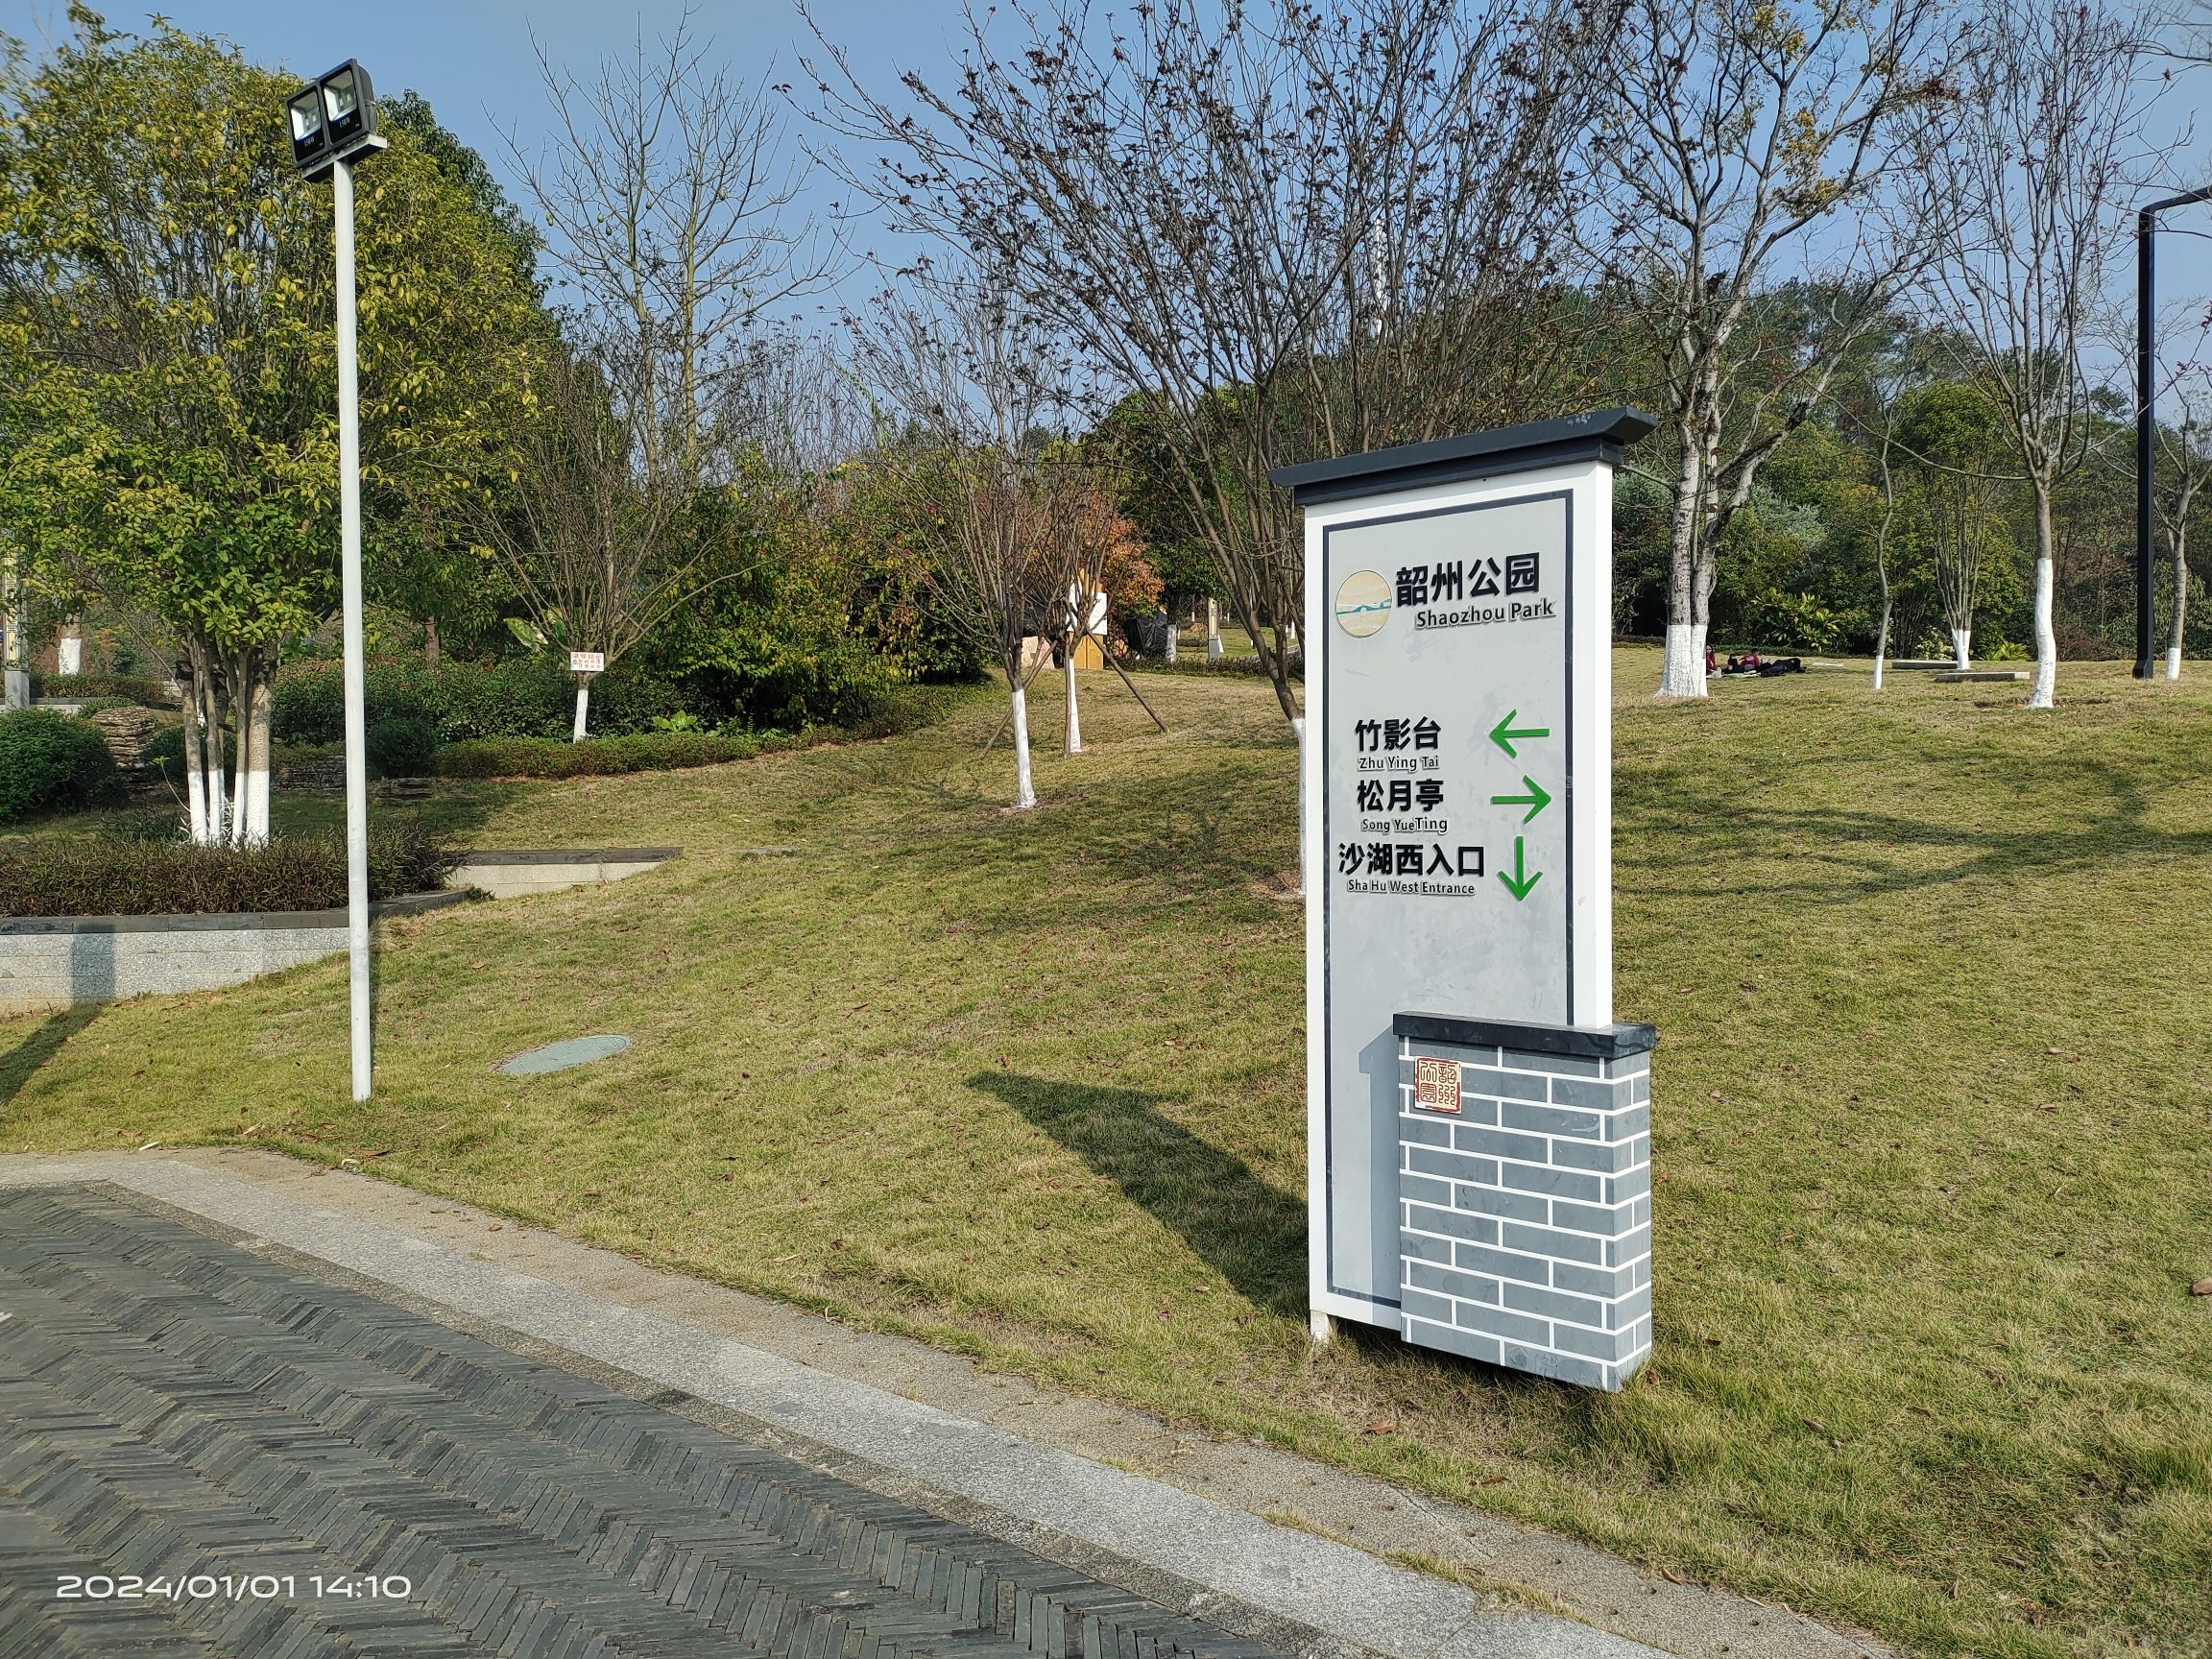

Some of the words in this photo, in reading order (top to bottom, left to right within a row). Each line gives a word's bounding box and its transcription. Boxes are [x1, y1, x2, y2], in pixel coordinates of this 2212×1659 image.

[1396, 552, 1540, 608] 韶州公园
[1416, 605, 1505, 628] Shaozhou
[1511, 598, 1553, 620] Park
[1355, 716, 1442, 752] 竹影台
[1358, 757, 1384, 770] Zhu
[1386, 756, 1417, 772] Ying
[1422, 756, 1439, 768] Tai
[1357, 779, 1444, 812] 松月亭
[1361, 818, 1390, 832] Song
[1337, 842, 1484, 878] 沙湖西入口
[1348, 878, 1368, 891] Sha
[1371, 880, 1386, 892] Hu
[1389, 881, 1419, 893] West
[1422, 881, 1475, 894] Entrance
